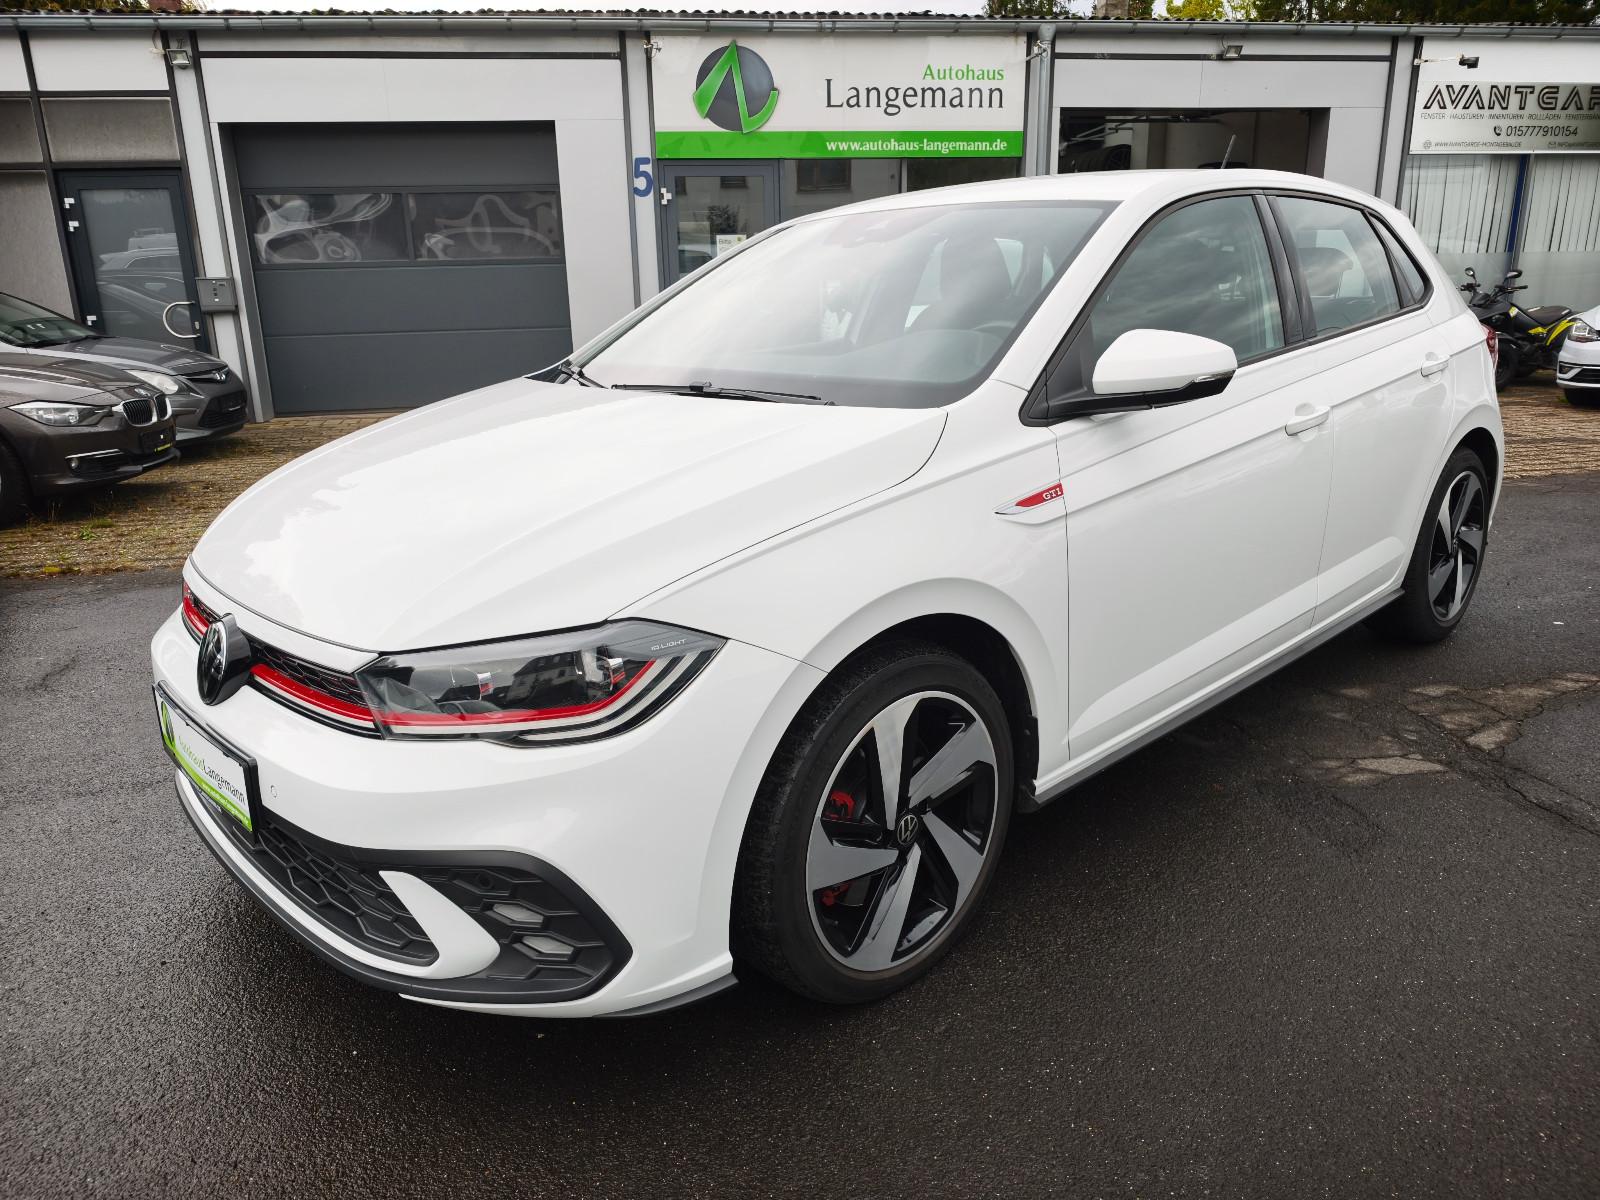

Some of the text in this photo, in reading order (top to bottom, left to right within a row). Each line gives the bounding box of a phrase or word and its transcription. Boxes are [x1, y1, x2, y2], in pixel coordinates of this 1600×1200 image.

[922, 64, 1005, 81] Autohaus
[825, 78, 1004, 117] Langemann
[1505, 125, 1579, 137] 015777910154
[826, 138, 1008, 154] www.autohaus-langemann.de
[632, 157, 654, 198] 5
[1042, 487, 1062, 501] GTI
